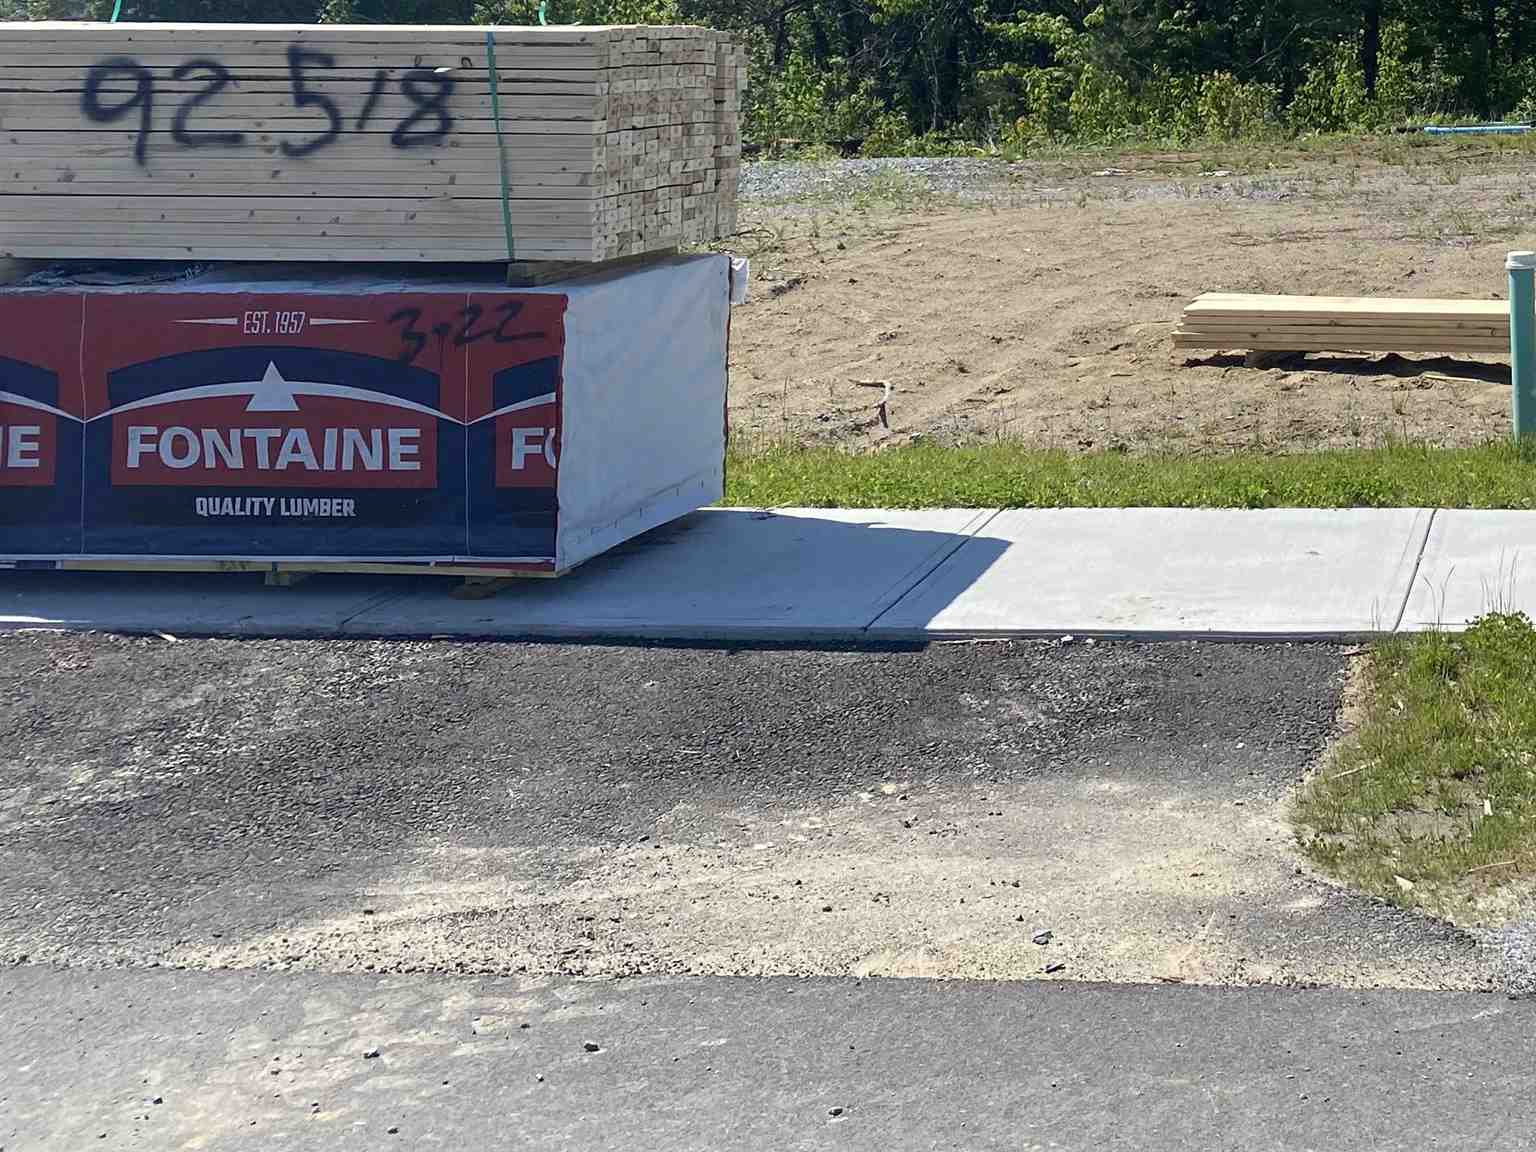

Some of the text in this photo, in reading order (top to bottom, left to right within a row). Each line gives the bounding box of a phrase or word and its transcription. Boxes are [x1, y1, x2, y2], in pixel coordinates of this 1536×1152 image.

[243, 311, 306, 334] EST. 1957
[126, 425, 421, 471] FONTAINE
[194, 496, 356, 517] QUALITY LUMBER
